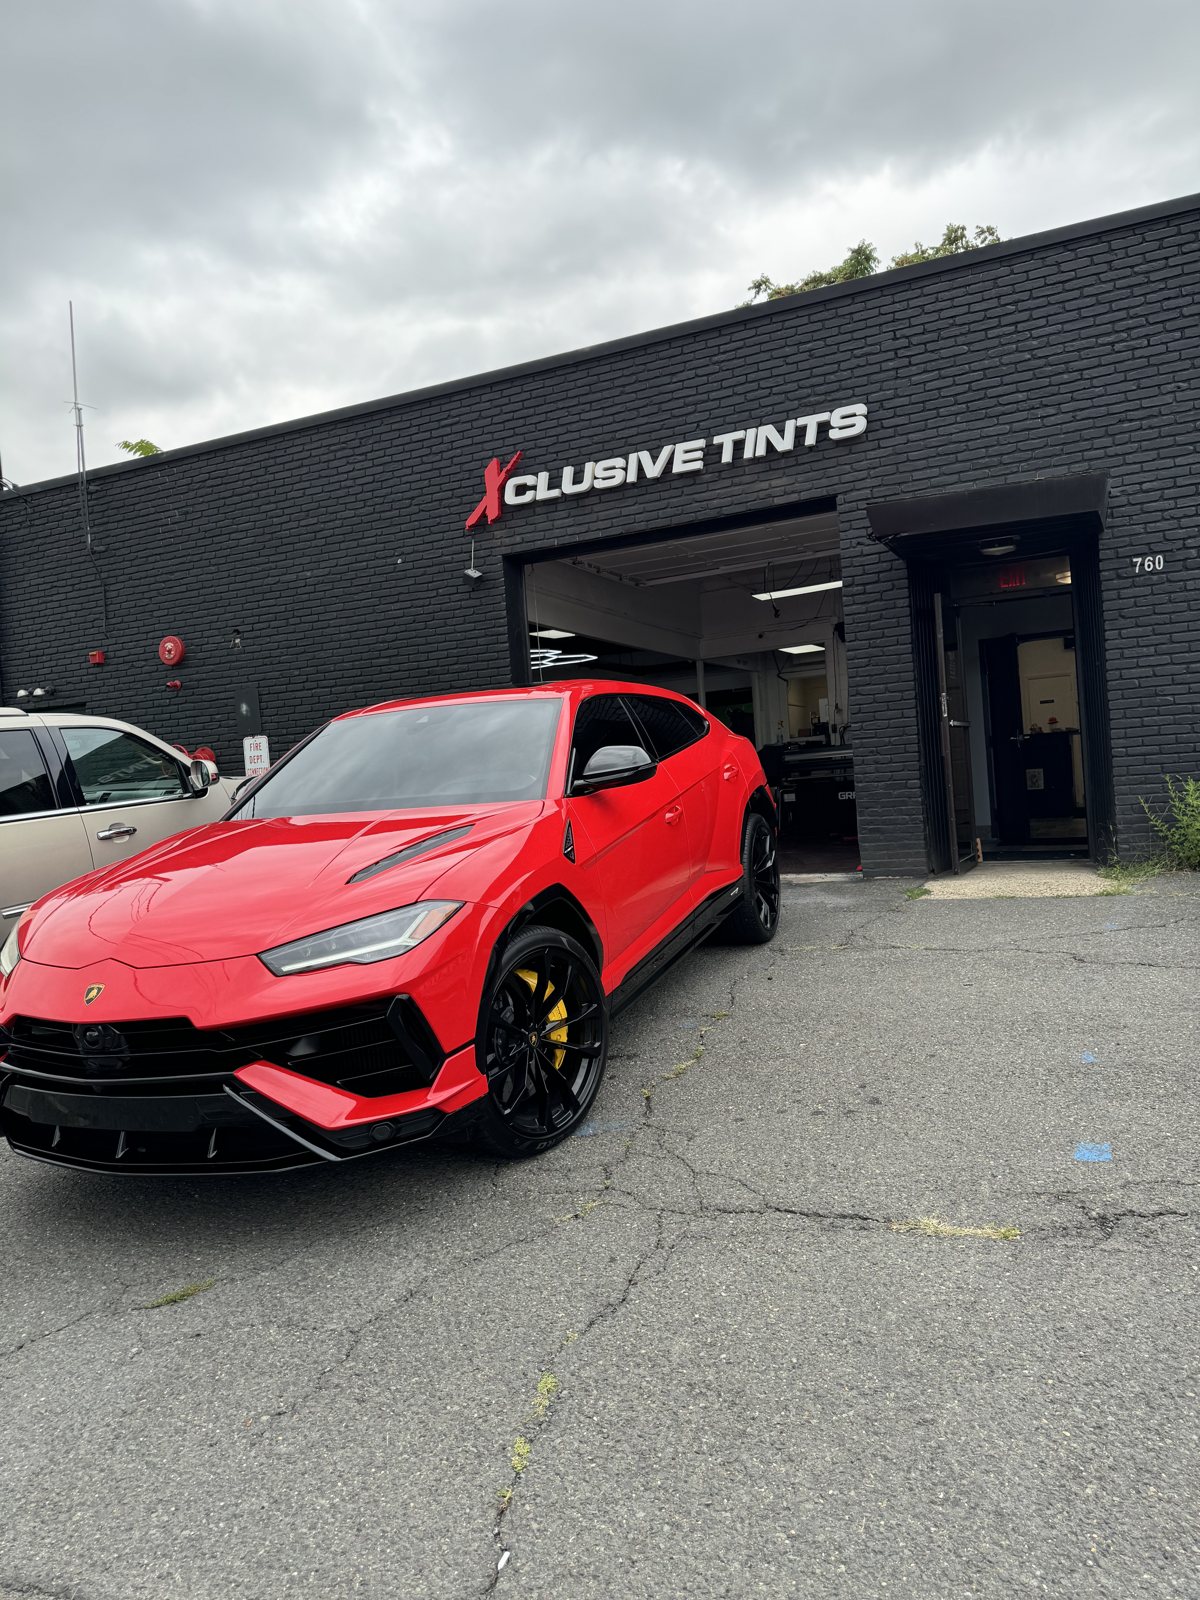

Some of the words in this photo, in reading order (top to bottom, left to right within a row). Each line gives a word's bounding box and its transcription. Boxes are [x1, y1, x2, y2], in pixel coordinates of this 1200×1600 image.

[465, 438, 706, 530] XCLUSIVE
[713, 402, 867, 464] TINTS
[1132, 555, 1164, 573] 760
[250, 742, 262, 752] FIRE
[249, 754, 265, 764] DEPT.
